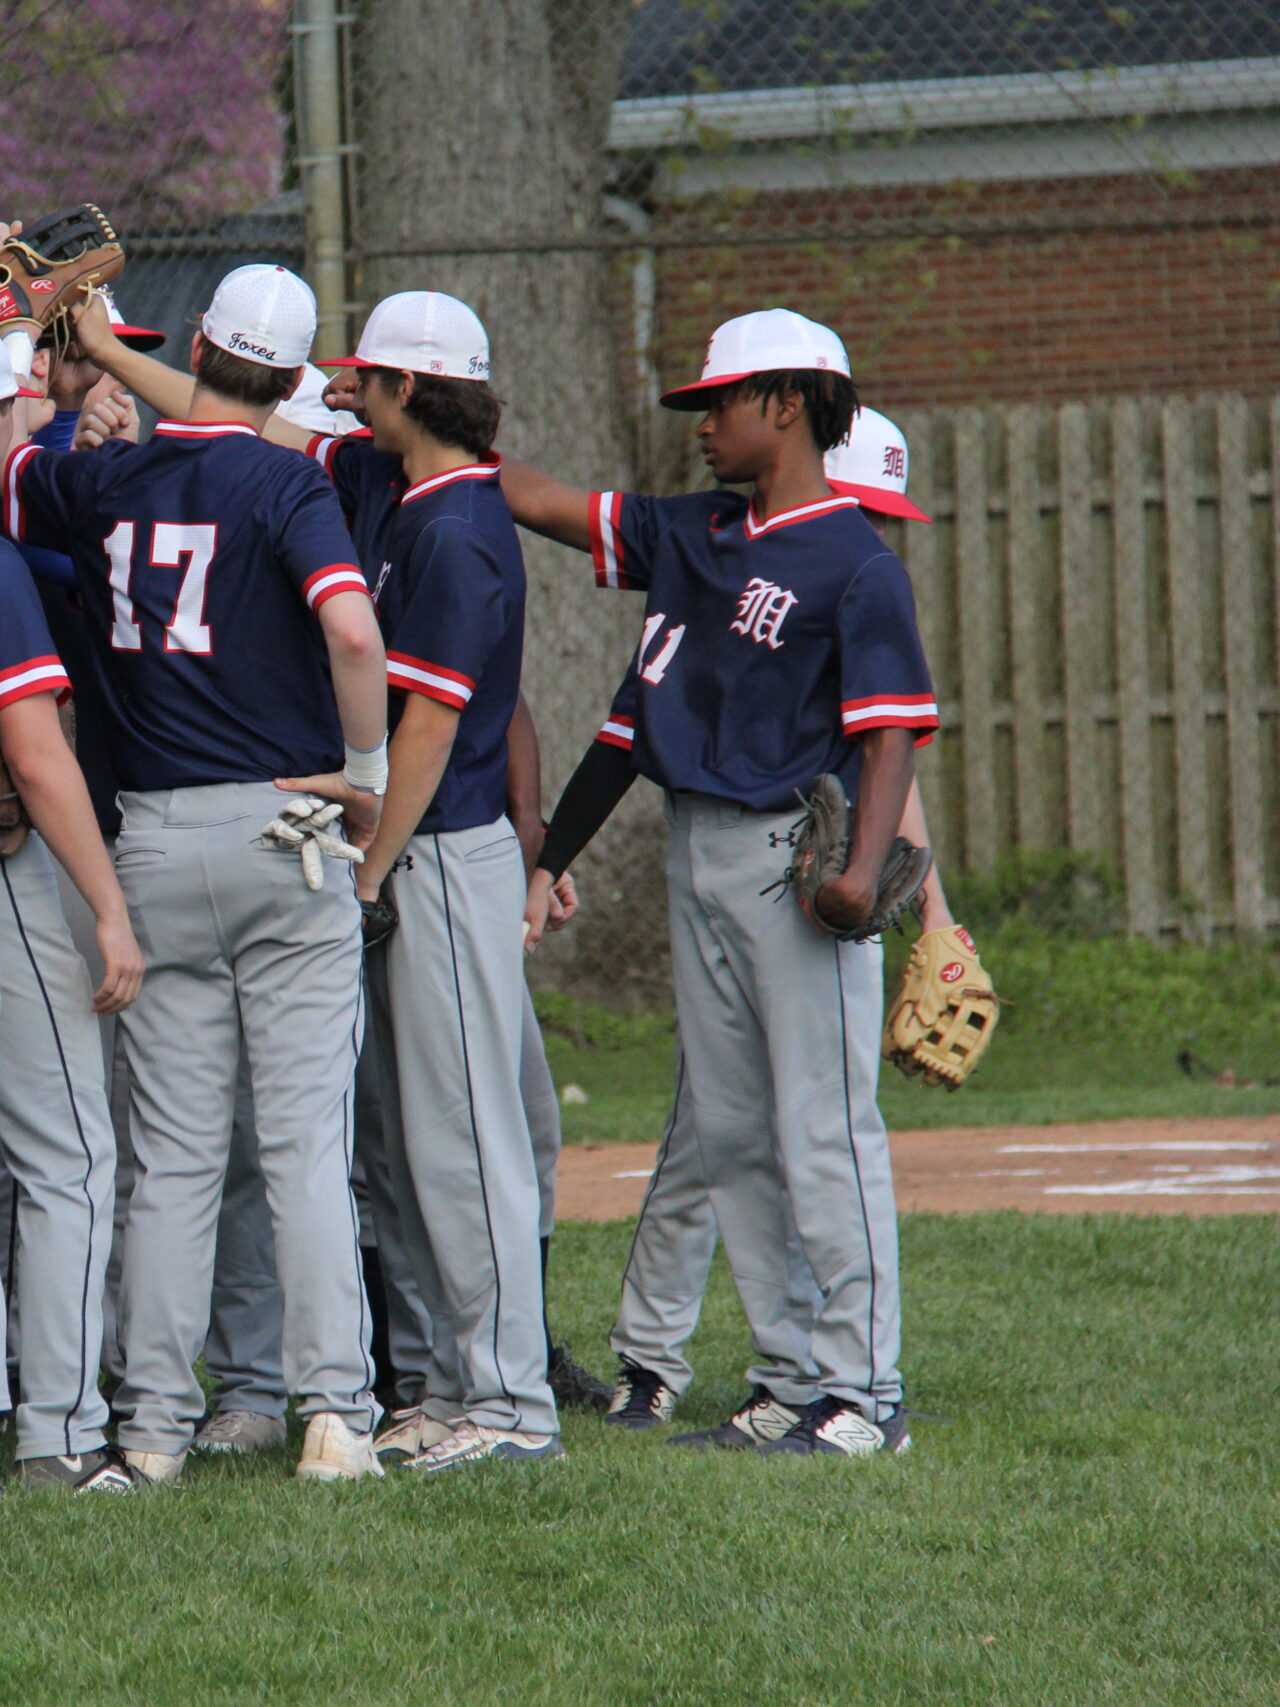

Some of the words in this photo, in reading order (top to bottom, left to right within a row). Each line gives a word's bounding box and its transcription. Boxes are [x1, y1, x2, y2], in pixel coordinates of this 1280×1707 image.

[228, 332, 277, 361] Foxes
[101, 520, 219, 655] 17
[637, 611, 688, 688] 11
